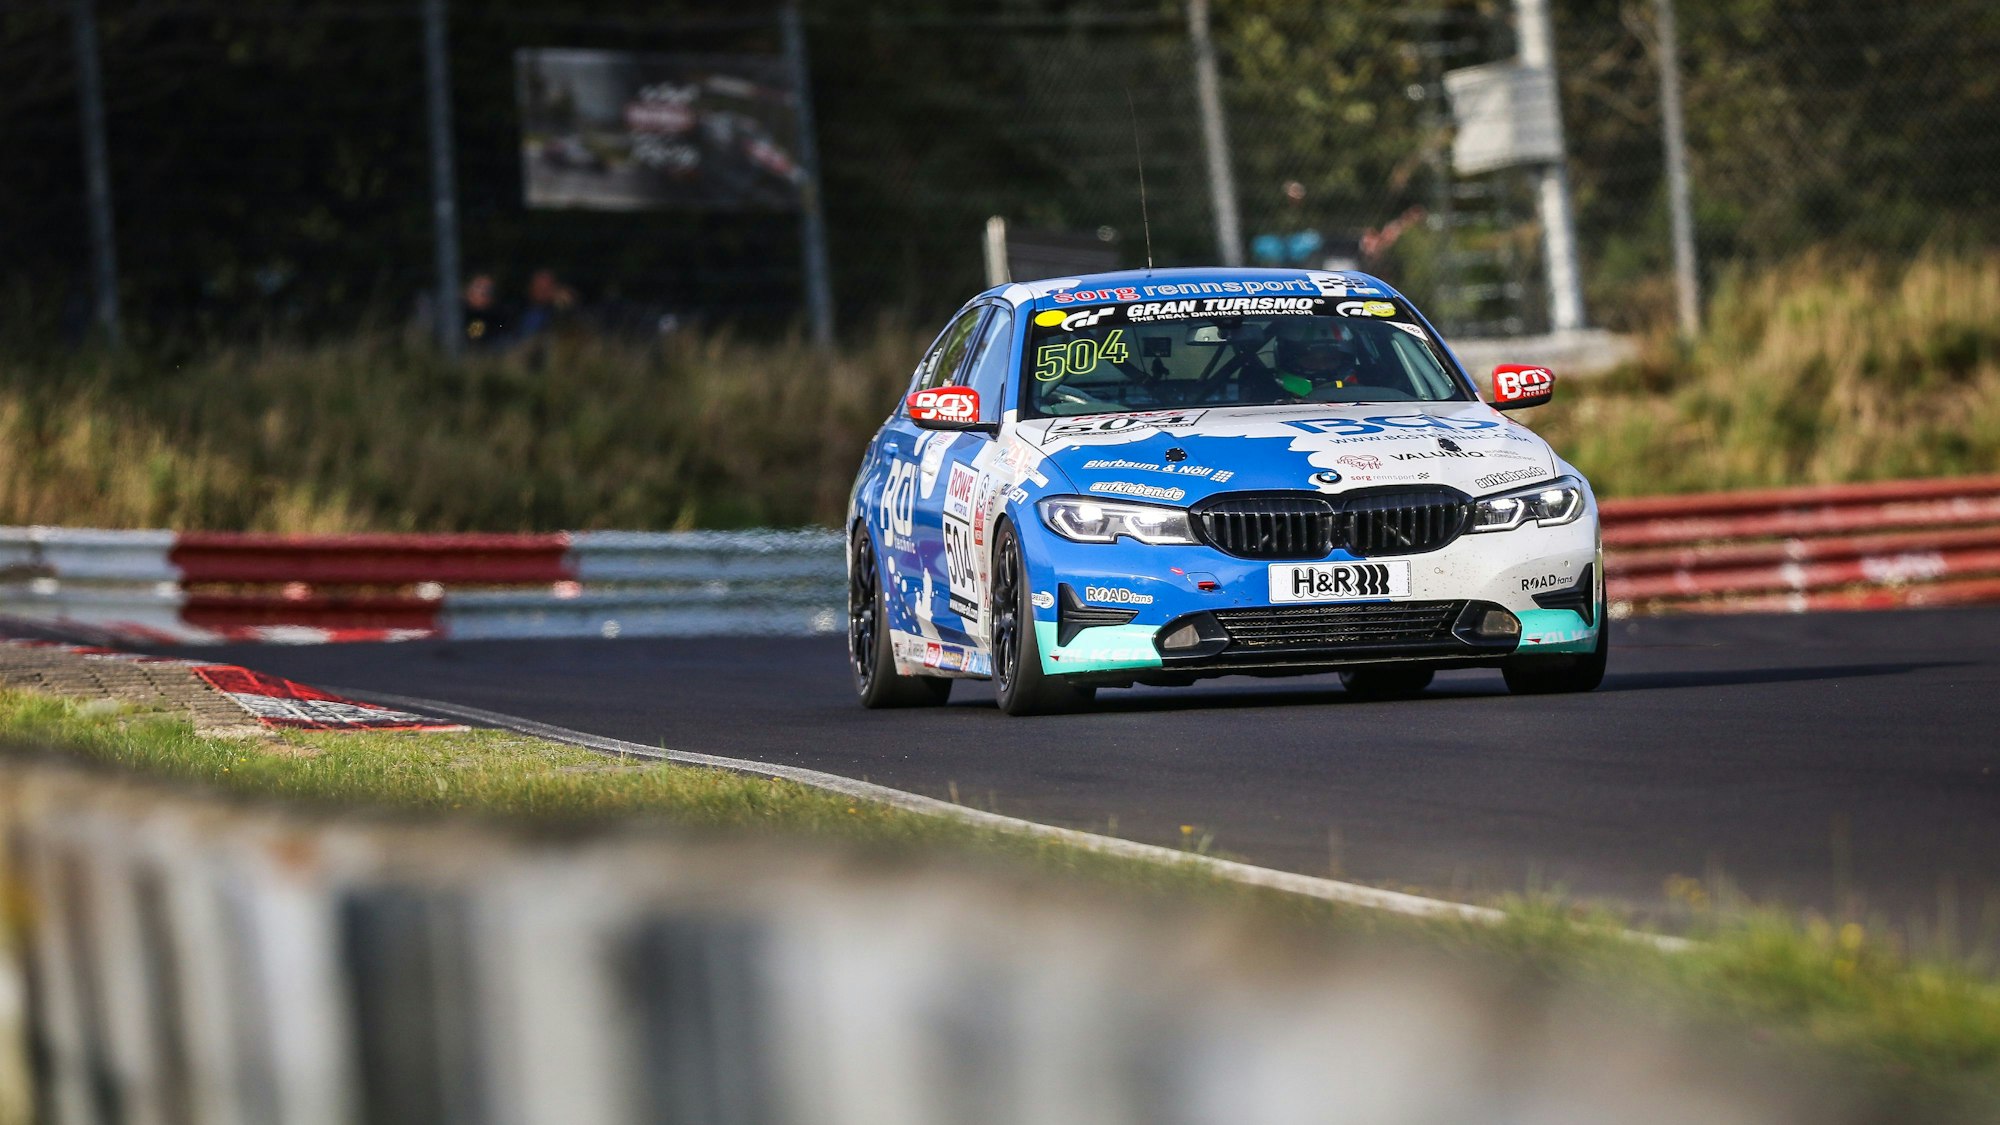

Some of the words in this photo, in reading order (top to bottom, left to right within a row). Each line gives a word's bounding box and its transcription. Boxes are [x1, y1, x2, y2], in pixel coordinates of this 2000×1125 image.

[1053, 287, 1141, 303] sorg
[1143, 279, 1314, 297] rennsport
[1127, 301, 1197, 318] GRAN
[1157, 313, 1189, 321] REAL
[1190, 310, 1241, 318] DRIVING
[1035, 329, 1129, 382] 504
[1497, 369, 1551, 399] BGS
[916, 392, 975, 420] BGS
[1051, 416, 1190, 434] 504
[1279, 413, 1500, 436] BGS
[1389, 451, 1486, 461] VALUNIQ
[1162, 465, 1175, 473] &
[1474, 465, 1547, 489] aufkleben.de
[948, 467, 974, 504] ROWE
[945, 522, 976, 593] 504
[1293, 567, 1354, 596] H&R
